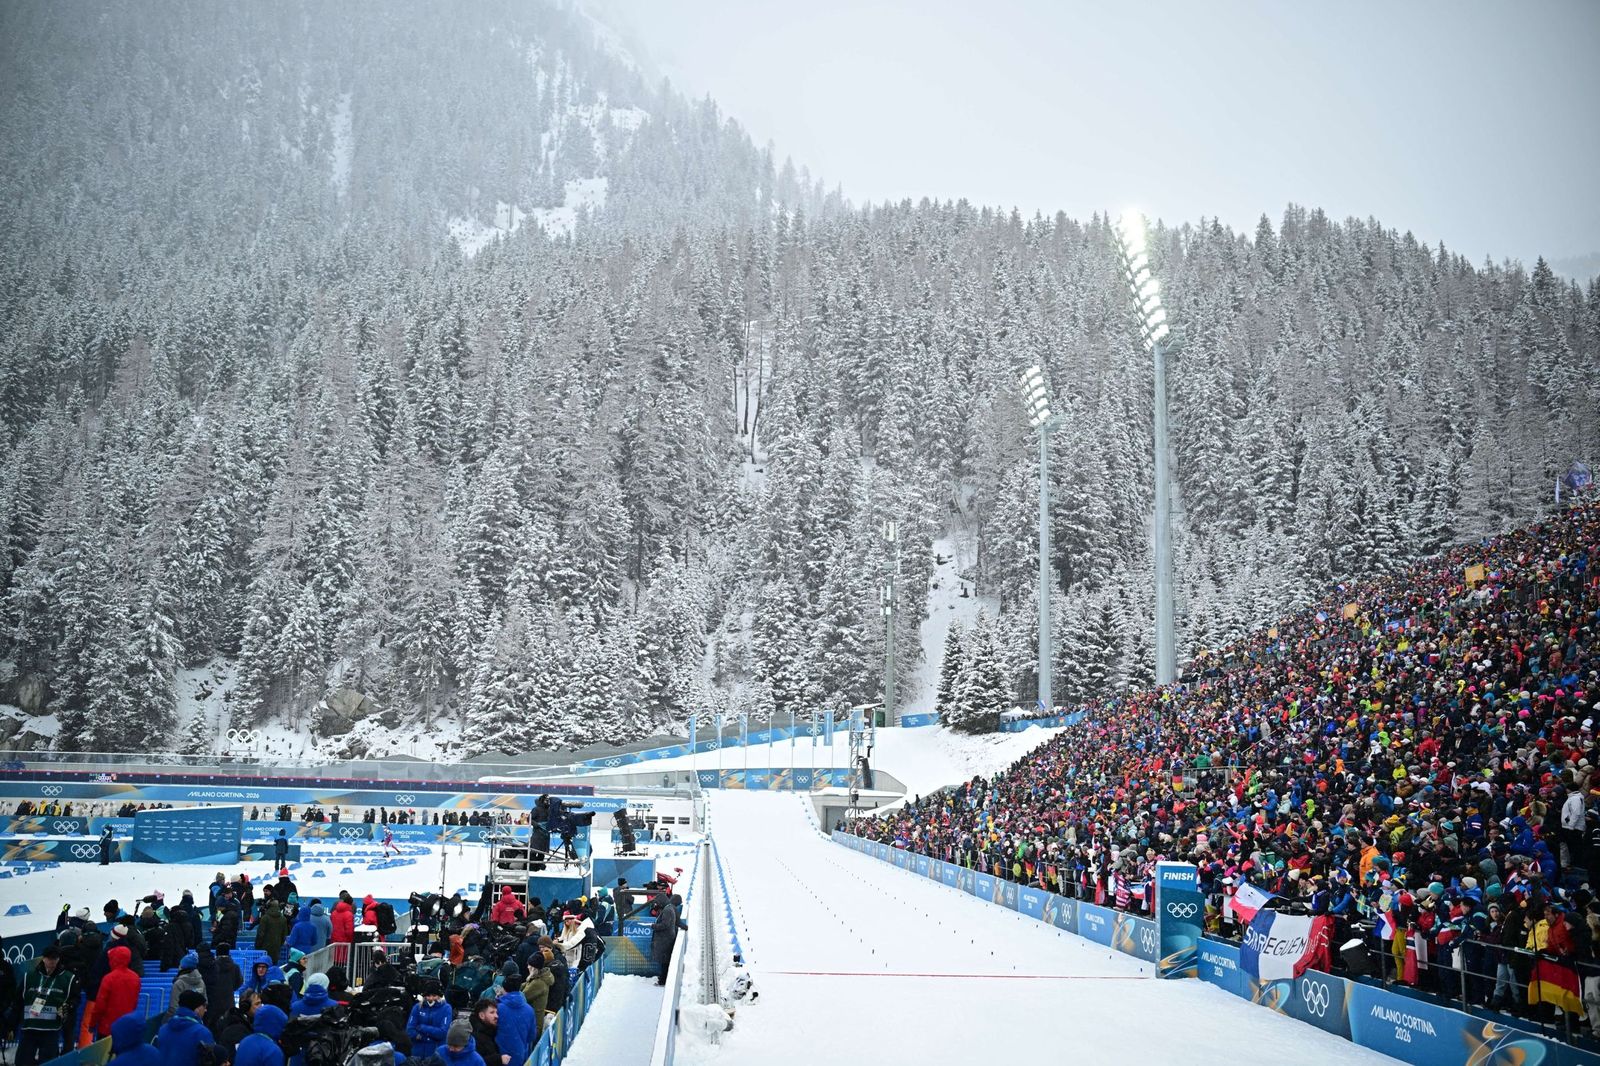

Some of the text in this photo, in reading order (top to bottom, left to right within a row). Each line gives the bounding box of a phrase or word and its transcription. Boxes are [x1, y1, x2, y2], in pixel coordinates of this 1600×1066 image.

[1163, 872, 1194, 881] FINISH
[1201, 951, 1237, 971] MILANO CORTINA
[1370, 1004, 1437, 1037] MILANO CORTINA
[1395, 1026, 1411, 1043] 2026
